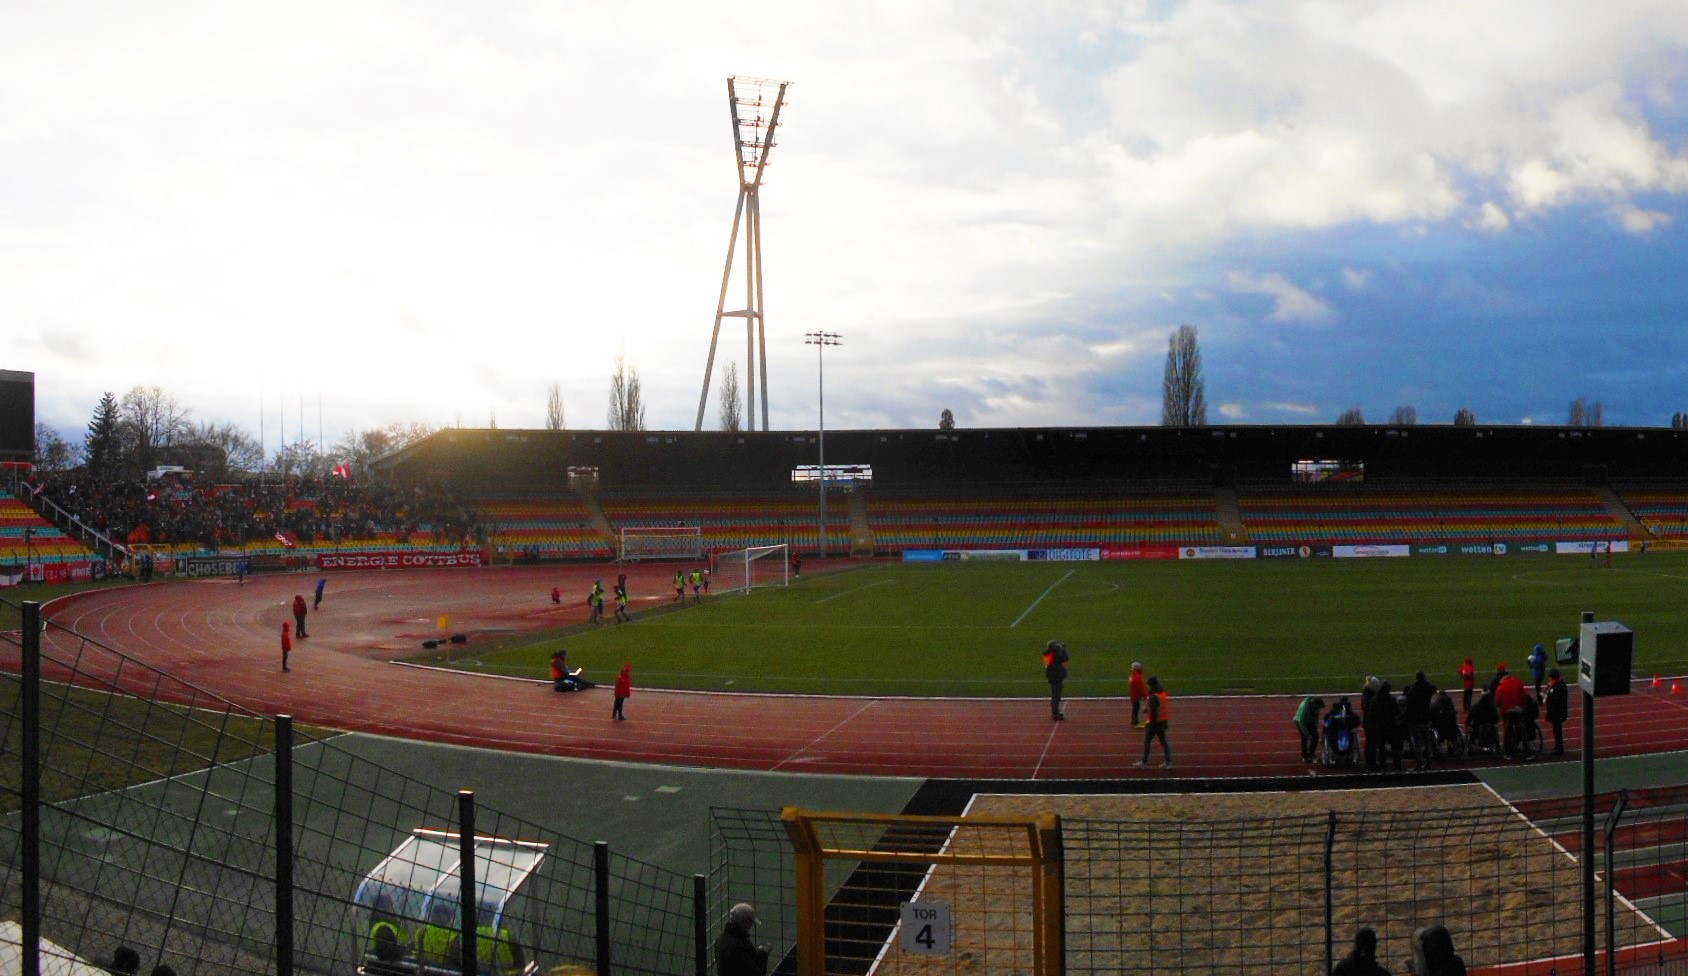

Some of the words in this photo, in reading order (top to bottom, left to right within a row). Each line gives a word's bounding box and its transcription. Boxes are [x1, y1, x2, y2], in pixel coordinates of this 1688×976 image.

[1263, 547, 1296, 557] BERLINER
[321, 556, 398, 567] ENERGIE
[402, 554, 481, 565] COTTBUS
[188, 561, 248, 576] CHOSEBU
[912, 908, 937, 920] TOR
[915, 924, 936, 949] 4
